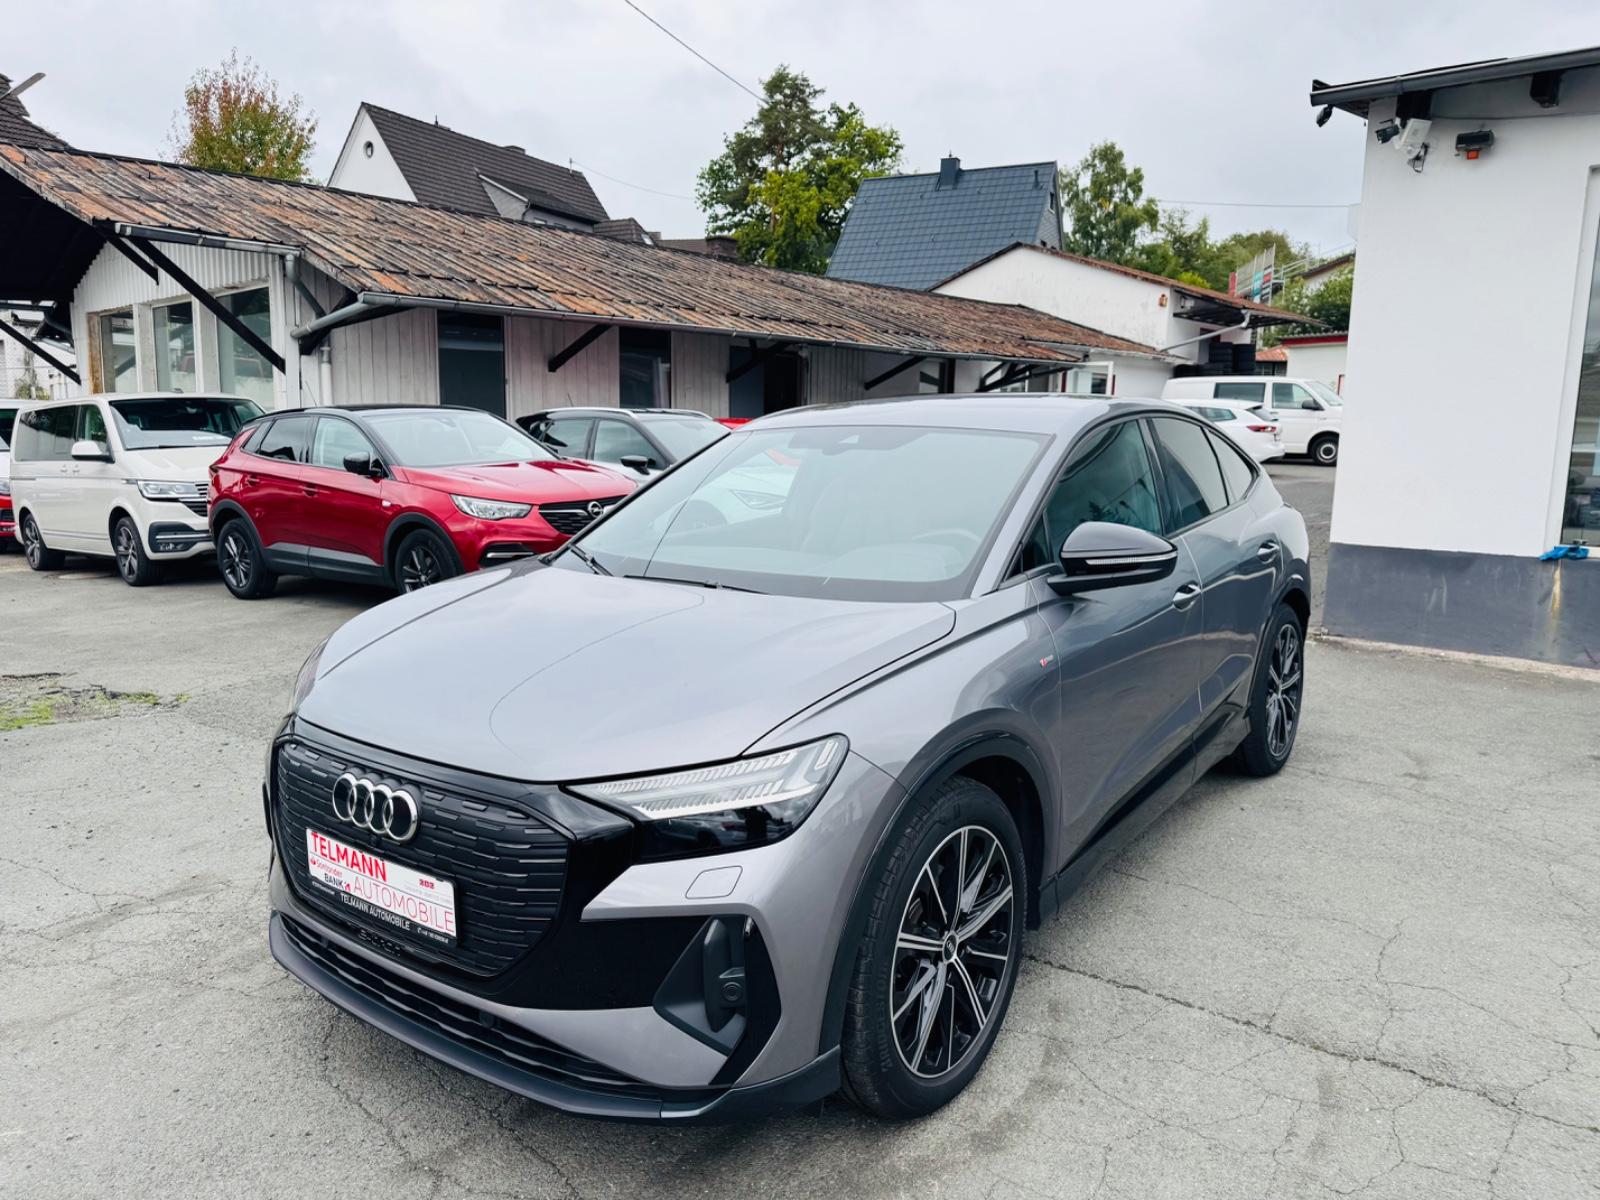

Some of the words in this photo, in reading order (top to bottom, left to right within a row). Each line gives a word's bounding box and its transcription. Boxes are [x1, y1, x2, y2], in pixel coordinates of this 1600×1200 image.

[310, 831, 387, 882] TELMANN
[324, 873, 345, 891] BANK
[353, 876, 455, 933] AUTOMOBILE
[340, 892, 369, 913] TELMANN
[369, 906, 411, 931] AUTOMOBILE
